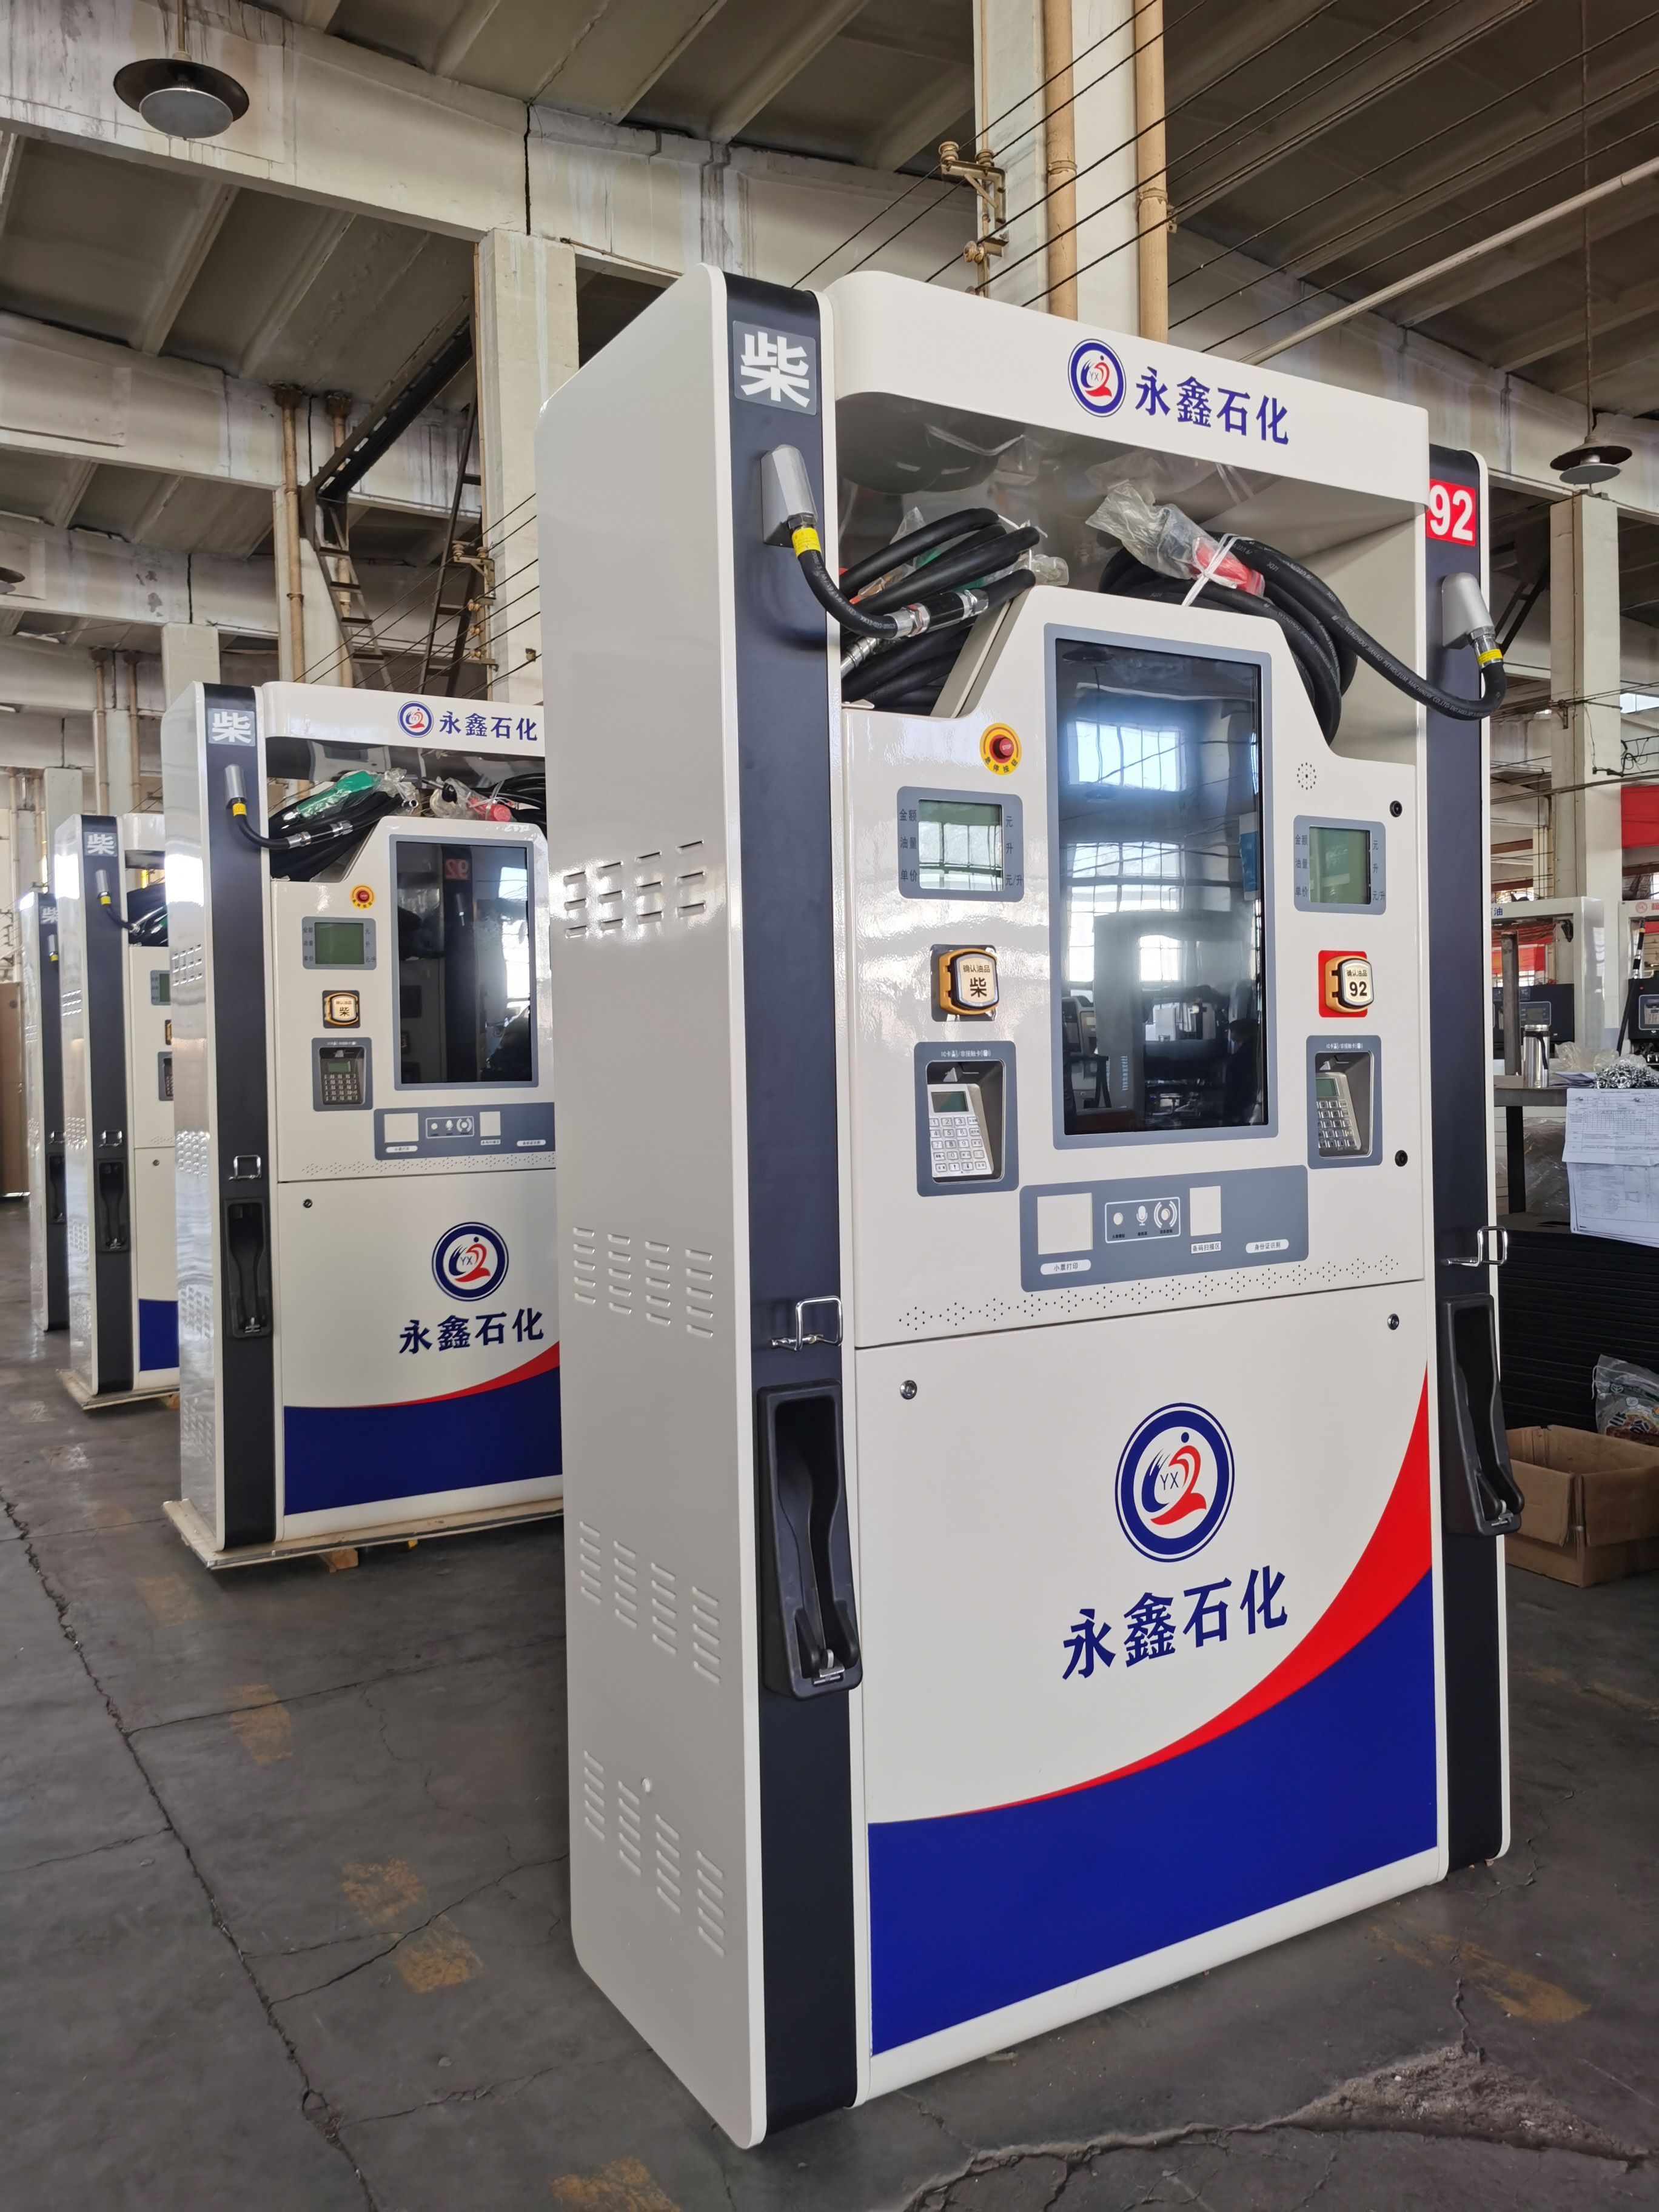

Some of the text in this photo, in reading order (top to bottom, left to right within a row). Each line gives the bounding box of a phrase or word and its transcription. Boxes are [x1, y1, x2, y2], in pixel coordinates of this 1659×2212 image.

[740, 331, 810, 407] 柴
[1089, 370, 1099, 381] YX
[1135, 366, 1289, 444] 永鑫石化
[1430, 484, 1473, 541] 92
[212, 711, 252, 743] 柴
[440, 711, 537, 741] 永鑫石化
[899, 808, 917, 822] 金额
[1005, 816, 1013, 827] 元
[87, 834, 115, 855] 柴
[900, 836, 917, 849] 油量
[1295, 834, 1308, 845] 金额
[1372, 840, 1378, 850] 元
[1006, 843, 1013, 854] 升
[1372, 863, 1378, 873] 升
[900, 869, 917, 882] 单价
[1005, 874, 1023, 886] 元/升
[1295, 886, 1308, 897] 单价
[1372, 890, 1385, 901] 元/升
[970, 977, 987, 997] 柴
[1349, 981, 1367, 996] 92
[340, 1007, 350, 1016] 柴
[1192, 1243, 1220, 1252] 条码扫描区
[1255, 1241, 1281, 1251] 身份证识别
[460, 1256, 473, 1265] YX
[1054, 1262, 1078, 1272] 小票打印
[399, 1307, 544, 1354] 永鑫石化
[1160, 1472, 1179, 1490] YX
[1062, 1566, 1287, 1680] 永鑫石化
